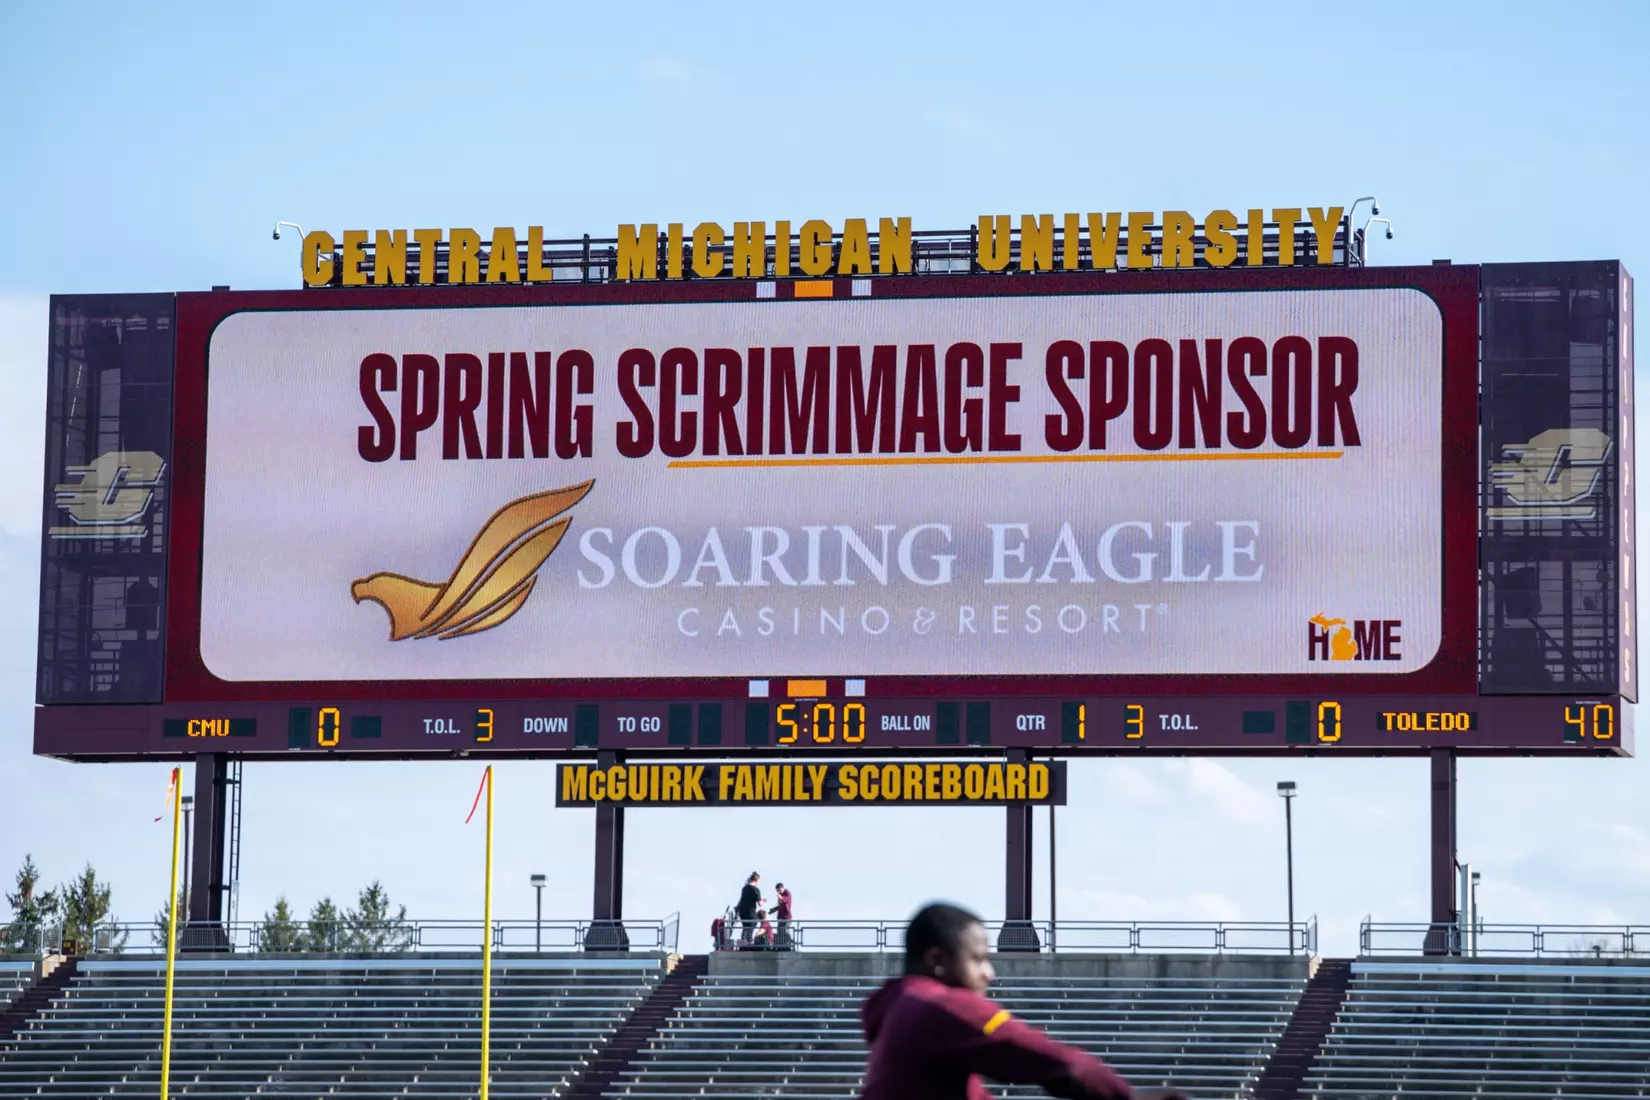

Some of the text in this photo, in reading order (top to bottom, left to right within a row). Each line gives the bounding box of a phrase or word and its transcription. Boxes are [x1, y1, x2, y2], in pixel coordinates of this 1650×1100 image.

[302, 206, 1345, 286] CENTRAL MICHIGAN UNIVERSITY
[358, 336, 1362, 462] SPRING SCRIMMAGE SPONSOR
[576, 520, 1264, 589] SOARING EAGLE
[677, 605, 890, 637] CASINO
[912, 609, 936, 635] &
[187, 719, 230, 737] CMU
[317, 707, 340, 747] 0
[423, 718, 461, 734] T.O.L.
[477, 708, 494, 742] 3
[523, 717, 568, 733] DOWN
[617, 716, 660, 732] TO GO
[776, 703, 866, 743] 5:00
[881, 714, 931, 731] BALL ON
[1016, 714, 1046, 731] QTR
[1126, 704, 1144, 739] 3
[1158, 714, 1198, 730] T.O.L.
[1318, 701, 1342, 742] 0
[1383, 712, 1470, 731] TOLEDO
[1564, 704, 1614, 739] 40
[562, 763, 1050, 801] McGUIRK FAMILY SCOREBOARD
